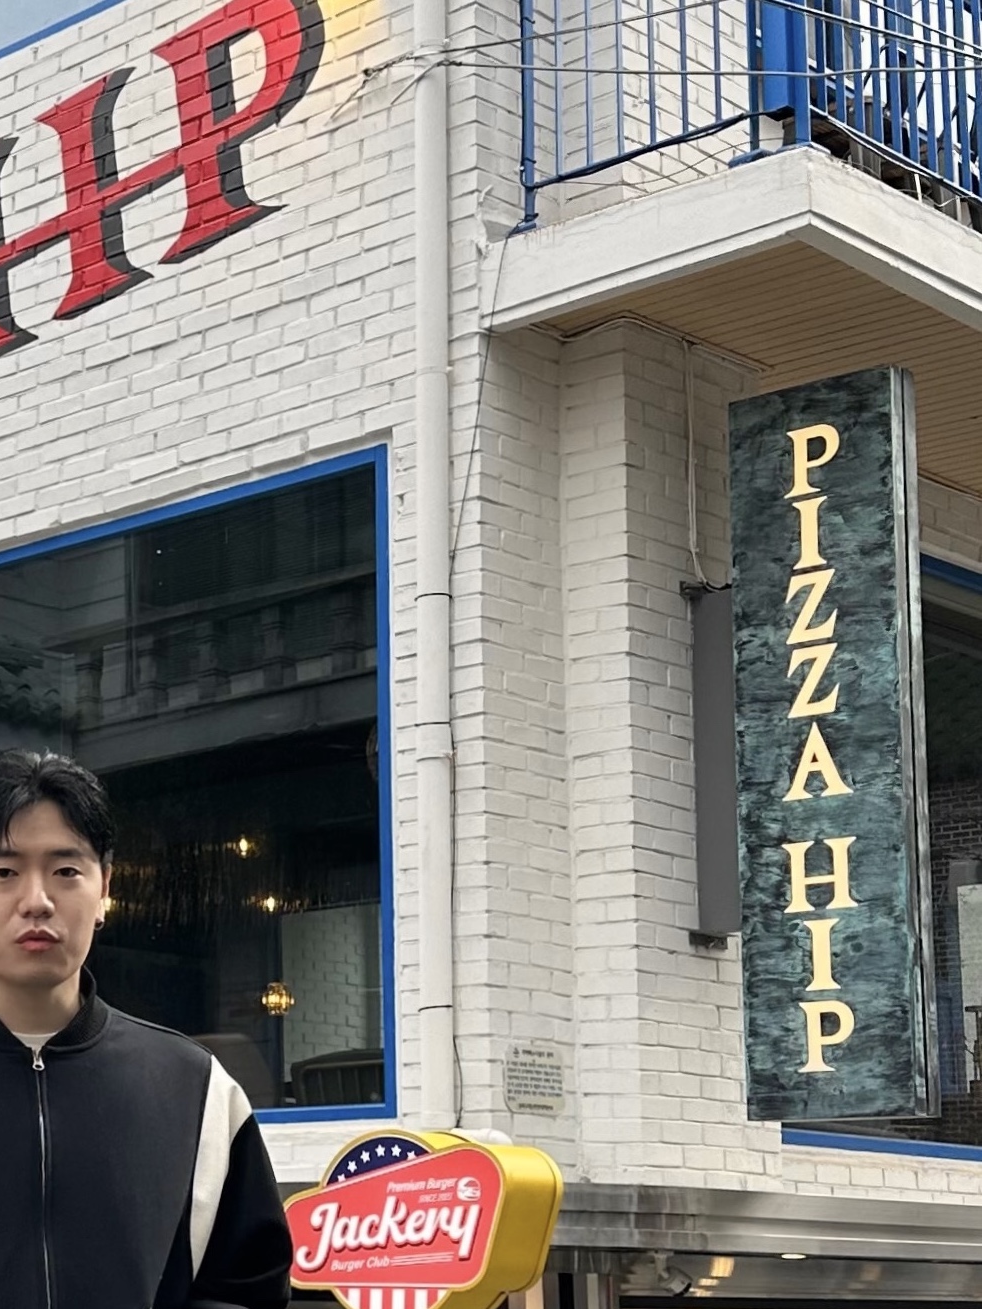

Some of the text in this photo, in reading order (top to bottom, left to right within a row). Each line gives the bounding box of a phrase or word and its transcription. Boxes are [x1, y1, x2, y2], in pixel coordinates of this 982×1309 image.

[781, 422, 859, 1074] PIZZA HIP
[386, 1177, 458, 1194] Premium Burger
[296, 1195, 481, 1274] Jackery
[331, 1255, 390, 1273] Burger Club
